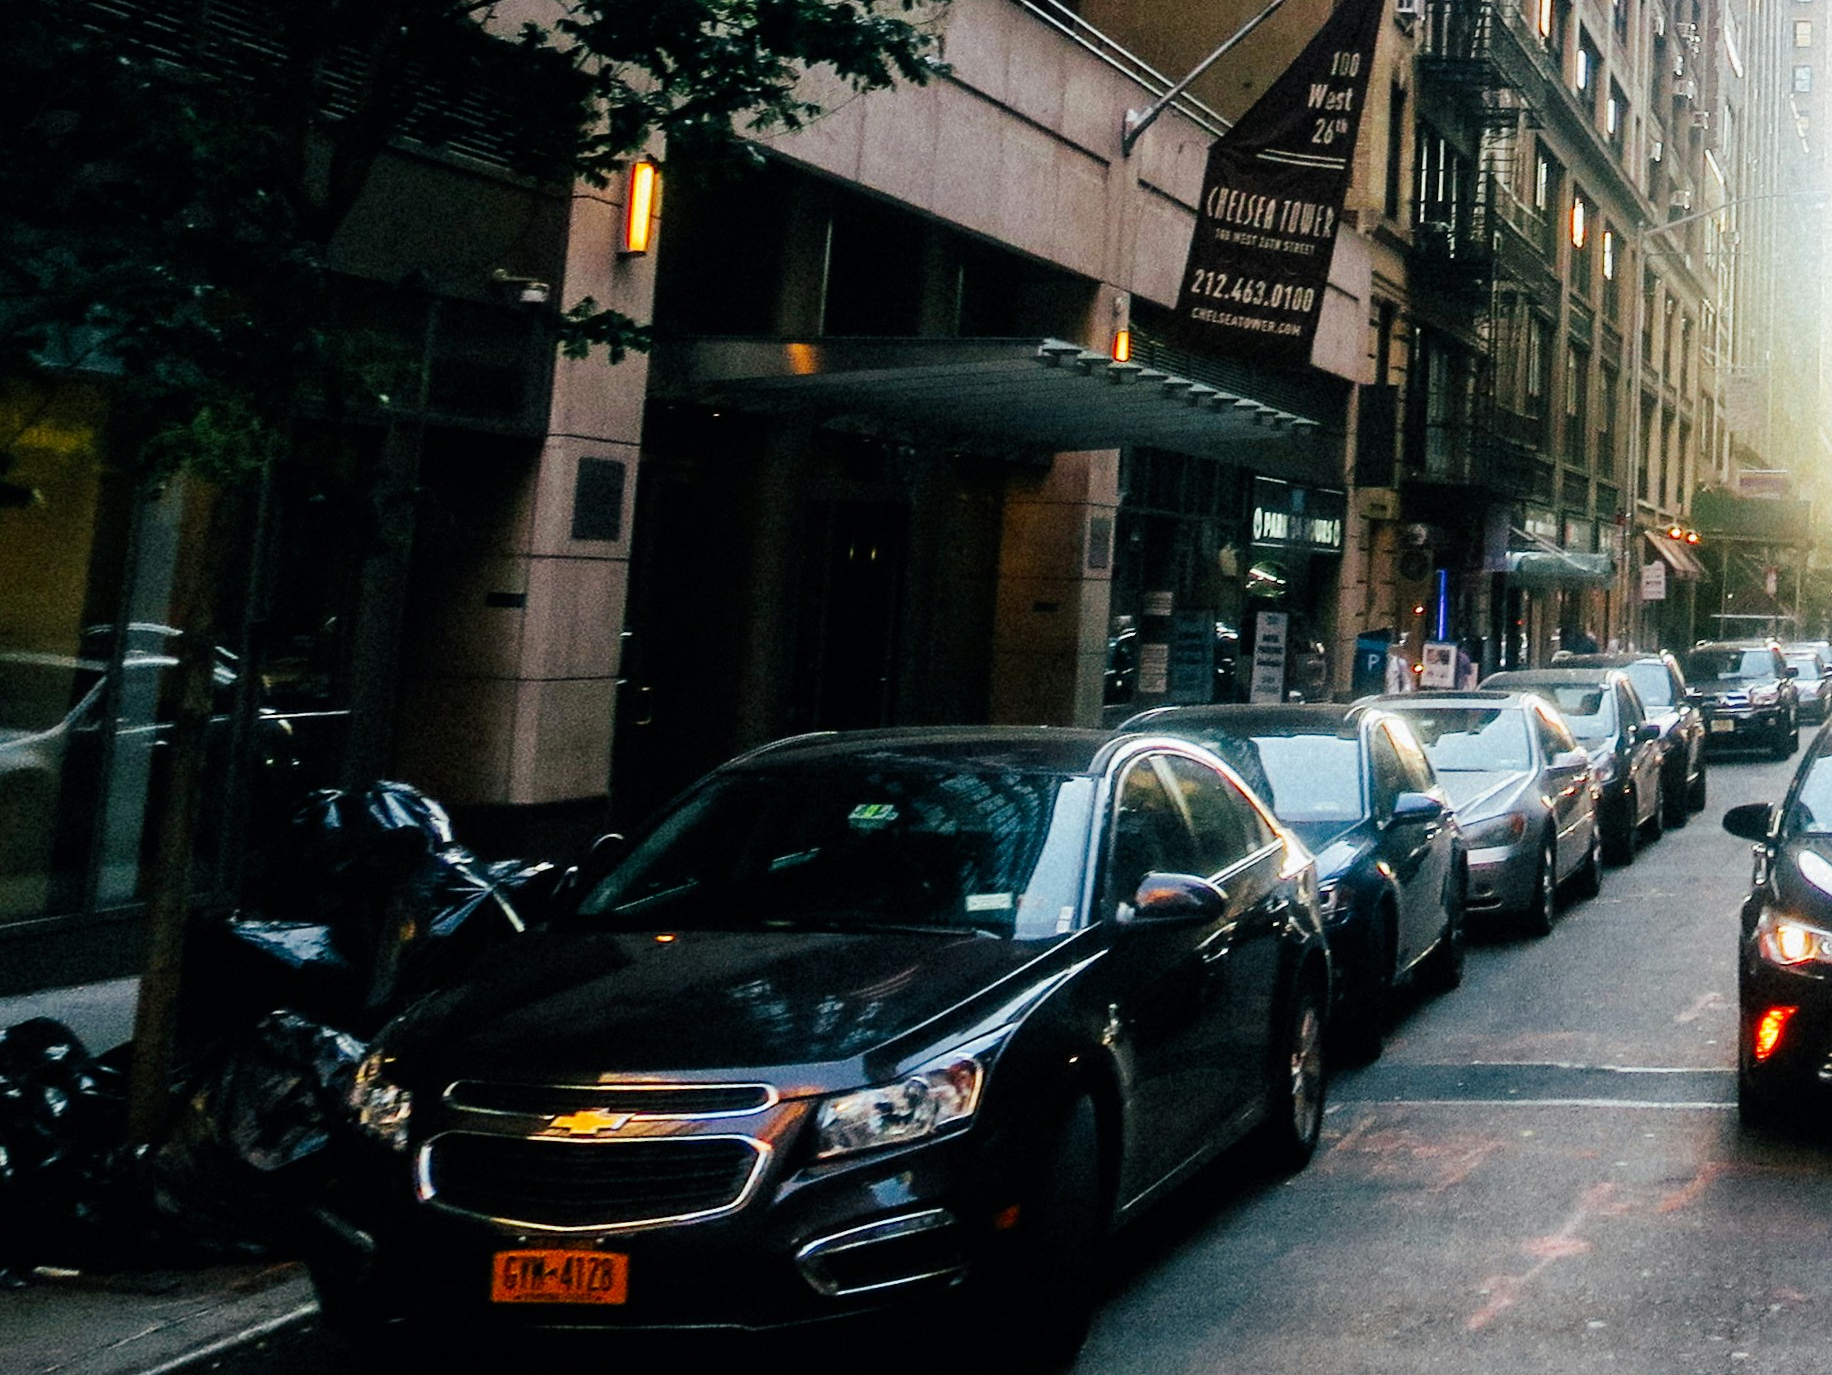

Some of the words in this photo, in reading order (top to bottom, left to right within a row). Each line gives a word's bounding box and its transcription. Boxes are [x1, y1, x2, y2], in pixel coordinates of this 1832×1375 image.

[1330, 51, 1361, 78] 100
[1307, 83, 1354, 112] West
[1206, 186, 1277, 230] CHELSEA
[1279, 200, 1335, 239] TOWER
[1283, 240, 1316, 256] STREET
[1190, 269, 1316, 313] 212.463.0100
